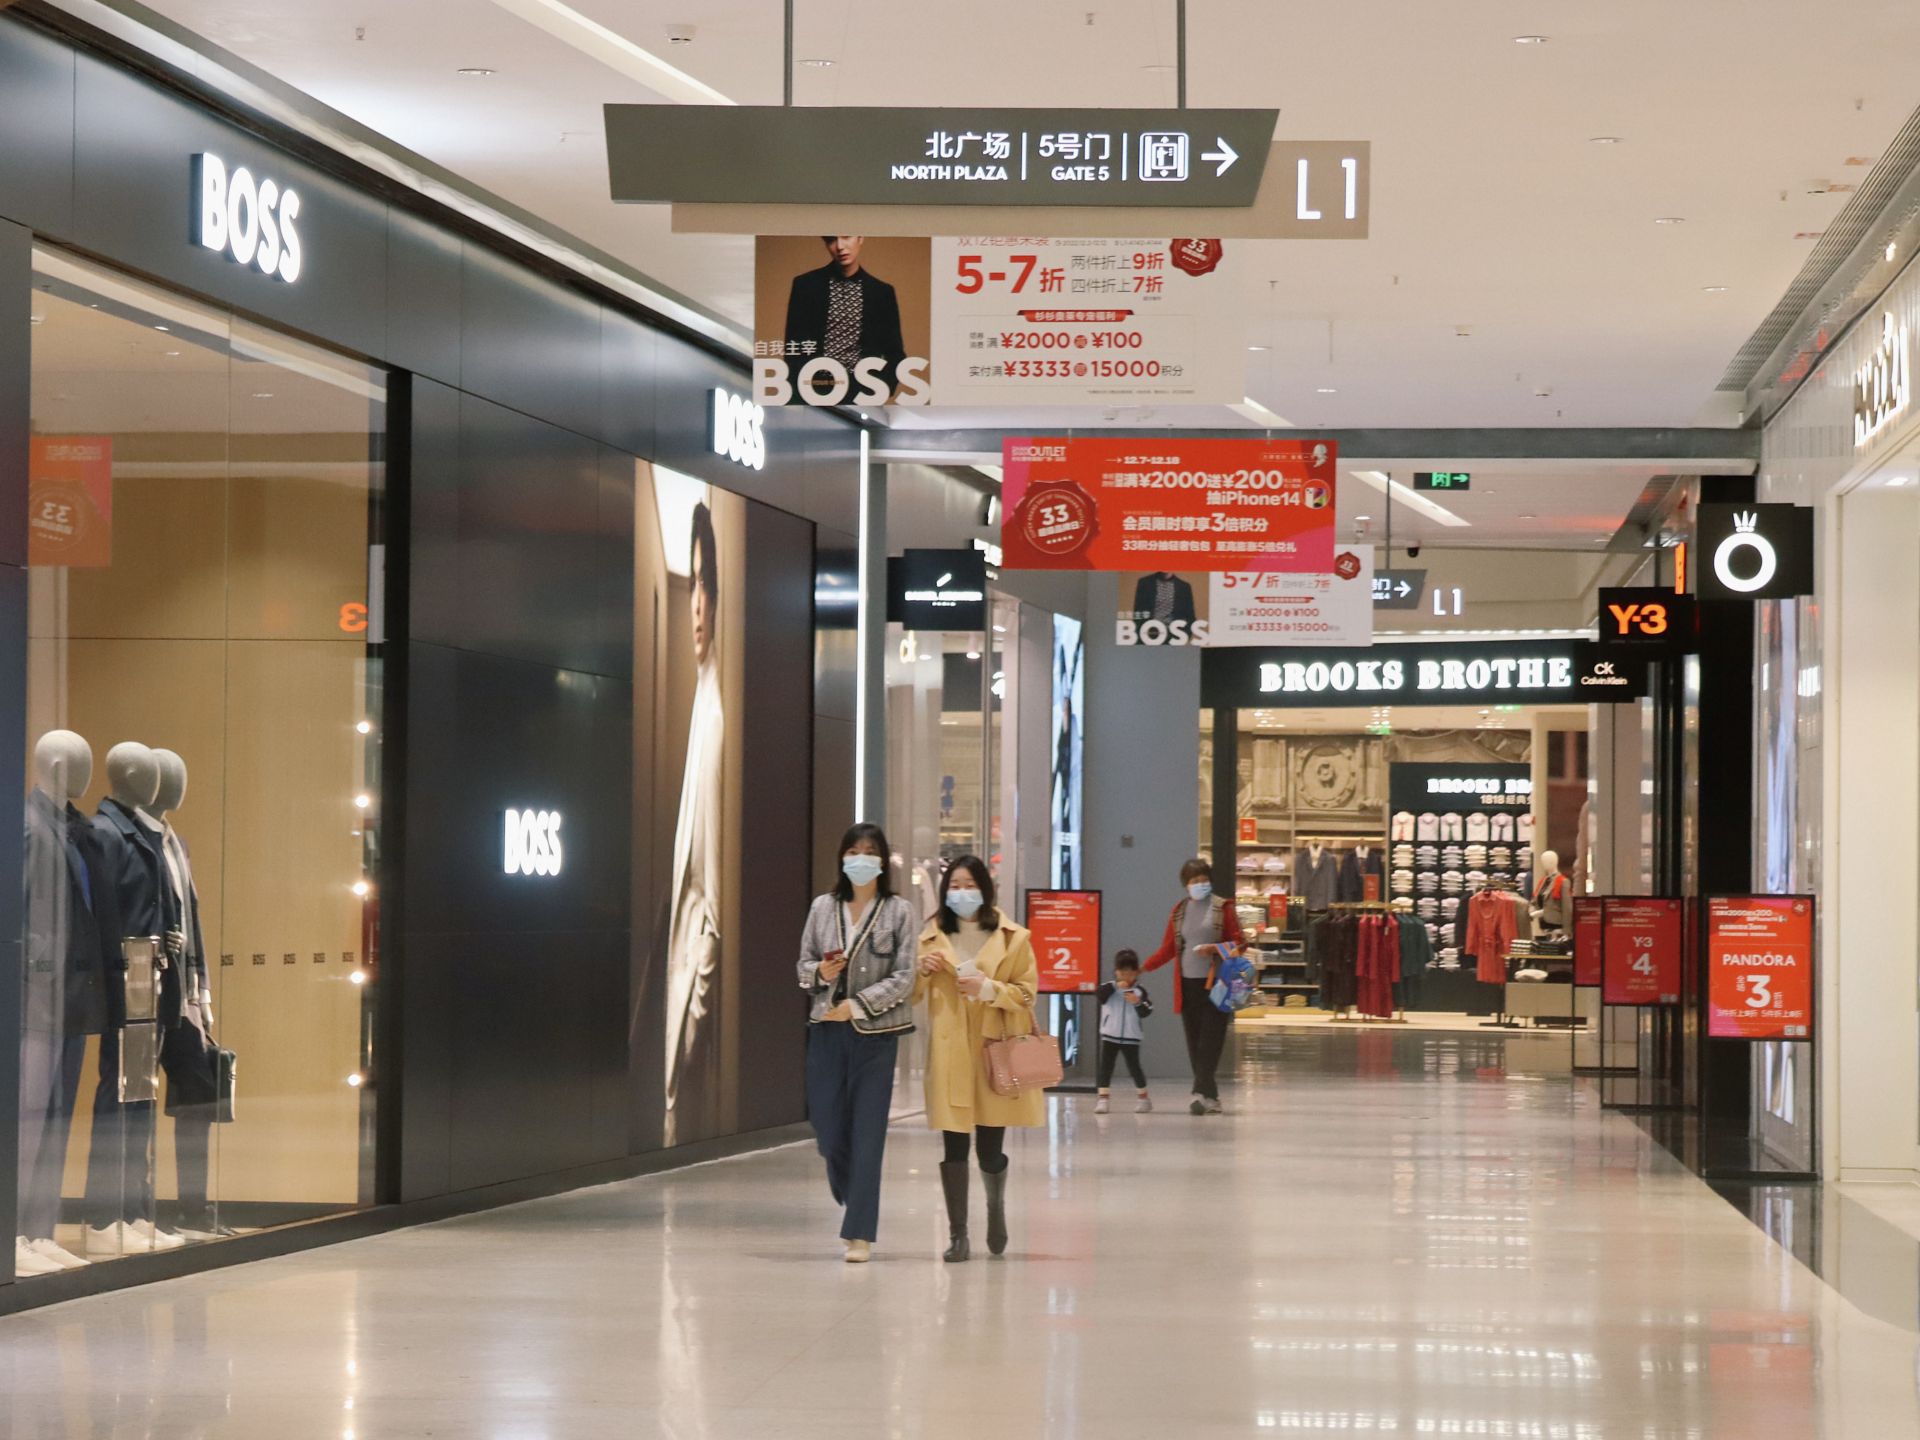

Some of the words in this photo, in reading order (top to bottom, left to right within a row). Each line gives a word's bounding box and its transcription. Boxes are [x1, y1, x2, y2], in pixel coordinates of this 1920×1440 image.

[925, 131, 1011, 158] 北广场
[1038, 133, 1111, 159] 5号门
[891, 166, 952, 181] NORTH
[954, 166, 1009, 181] PLAZA
[1051, 166, 1096, 181] GATE
[1097, 166, 1110, 181] 5
[202, 152, 301, 283] BOSS
[754, 340, 818, 356] 自我主宰
[753, 356, 932, 406] BOSS
[714, 387, 765, 471] BOSS
[1040, 503, 1069, 526] 33
[1608, 604, 1668, 635] Y-3
[1116, 620, 1210, 646] BOSS
[1259, 661, 1404, 692] BROOKS
[504, 809, 562, 876] BOSS
[1053, 947, 1071, 970] 2
[1632, 953, 1652, 976] 4
[1722, 952, 1796, 966] PANDORA
[1745, 974, 1771, 1008] 3
